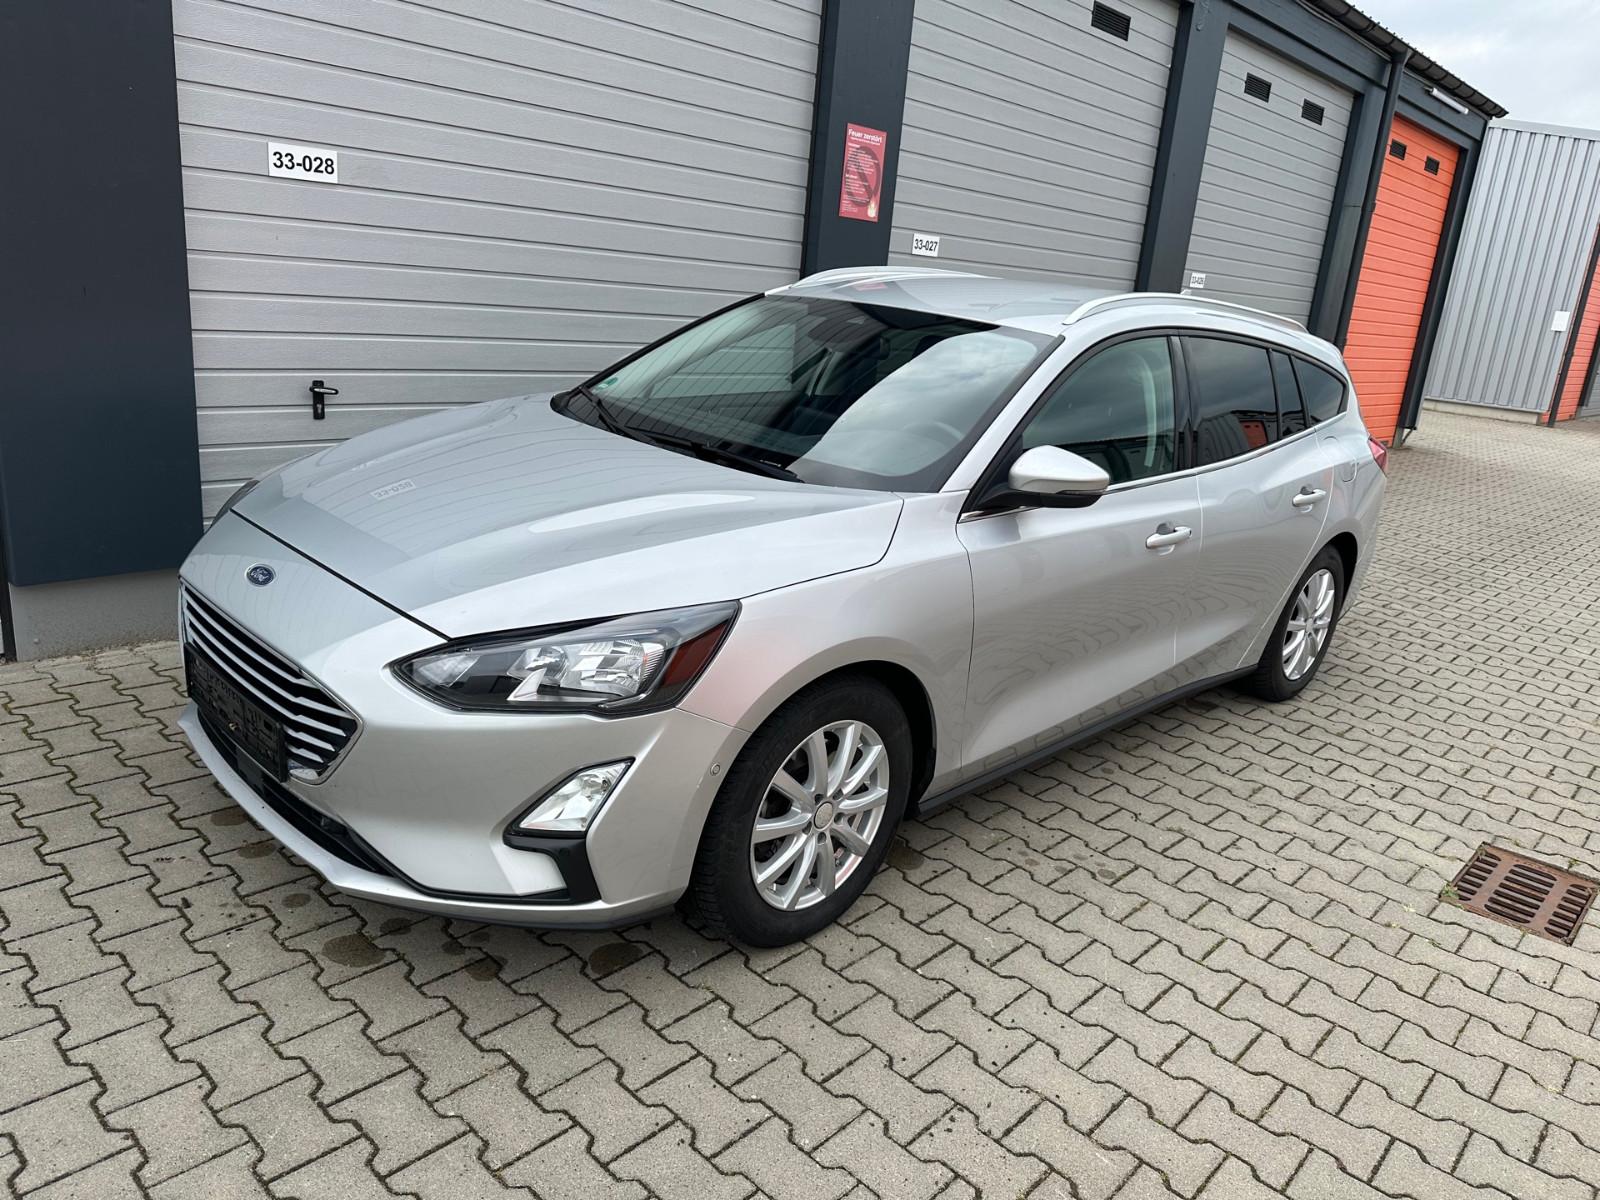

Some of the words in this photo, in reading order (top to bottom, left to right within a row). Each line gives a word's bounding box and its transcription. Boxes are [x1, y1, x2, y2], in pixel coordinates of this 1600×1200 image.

[272, 151, 335, 175] 33-028
[914, 238, 938, 252] 33-027
[249, 566, 271, 582] Ford
